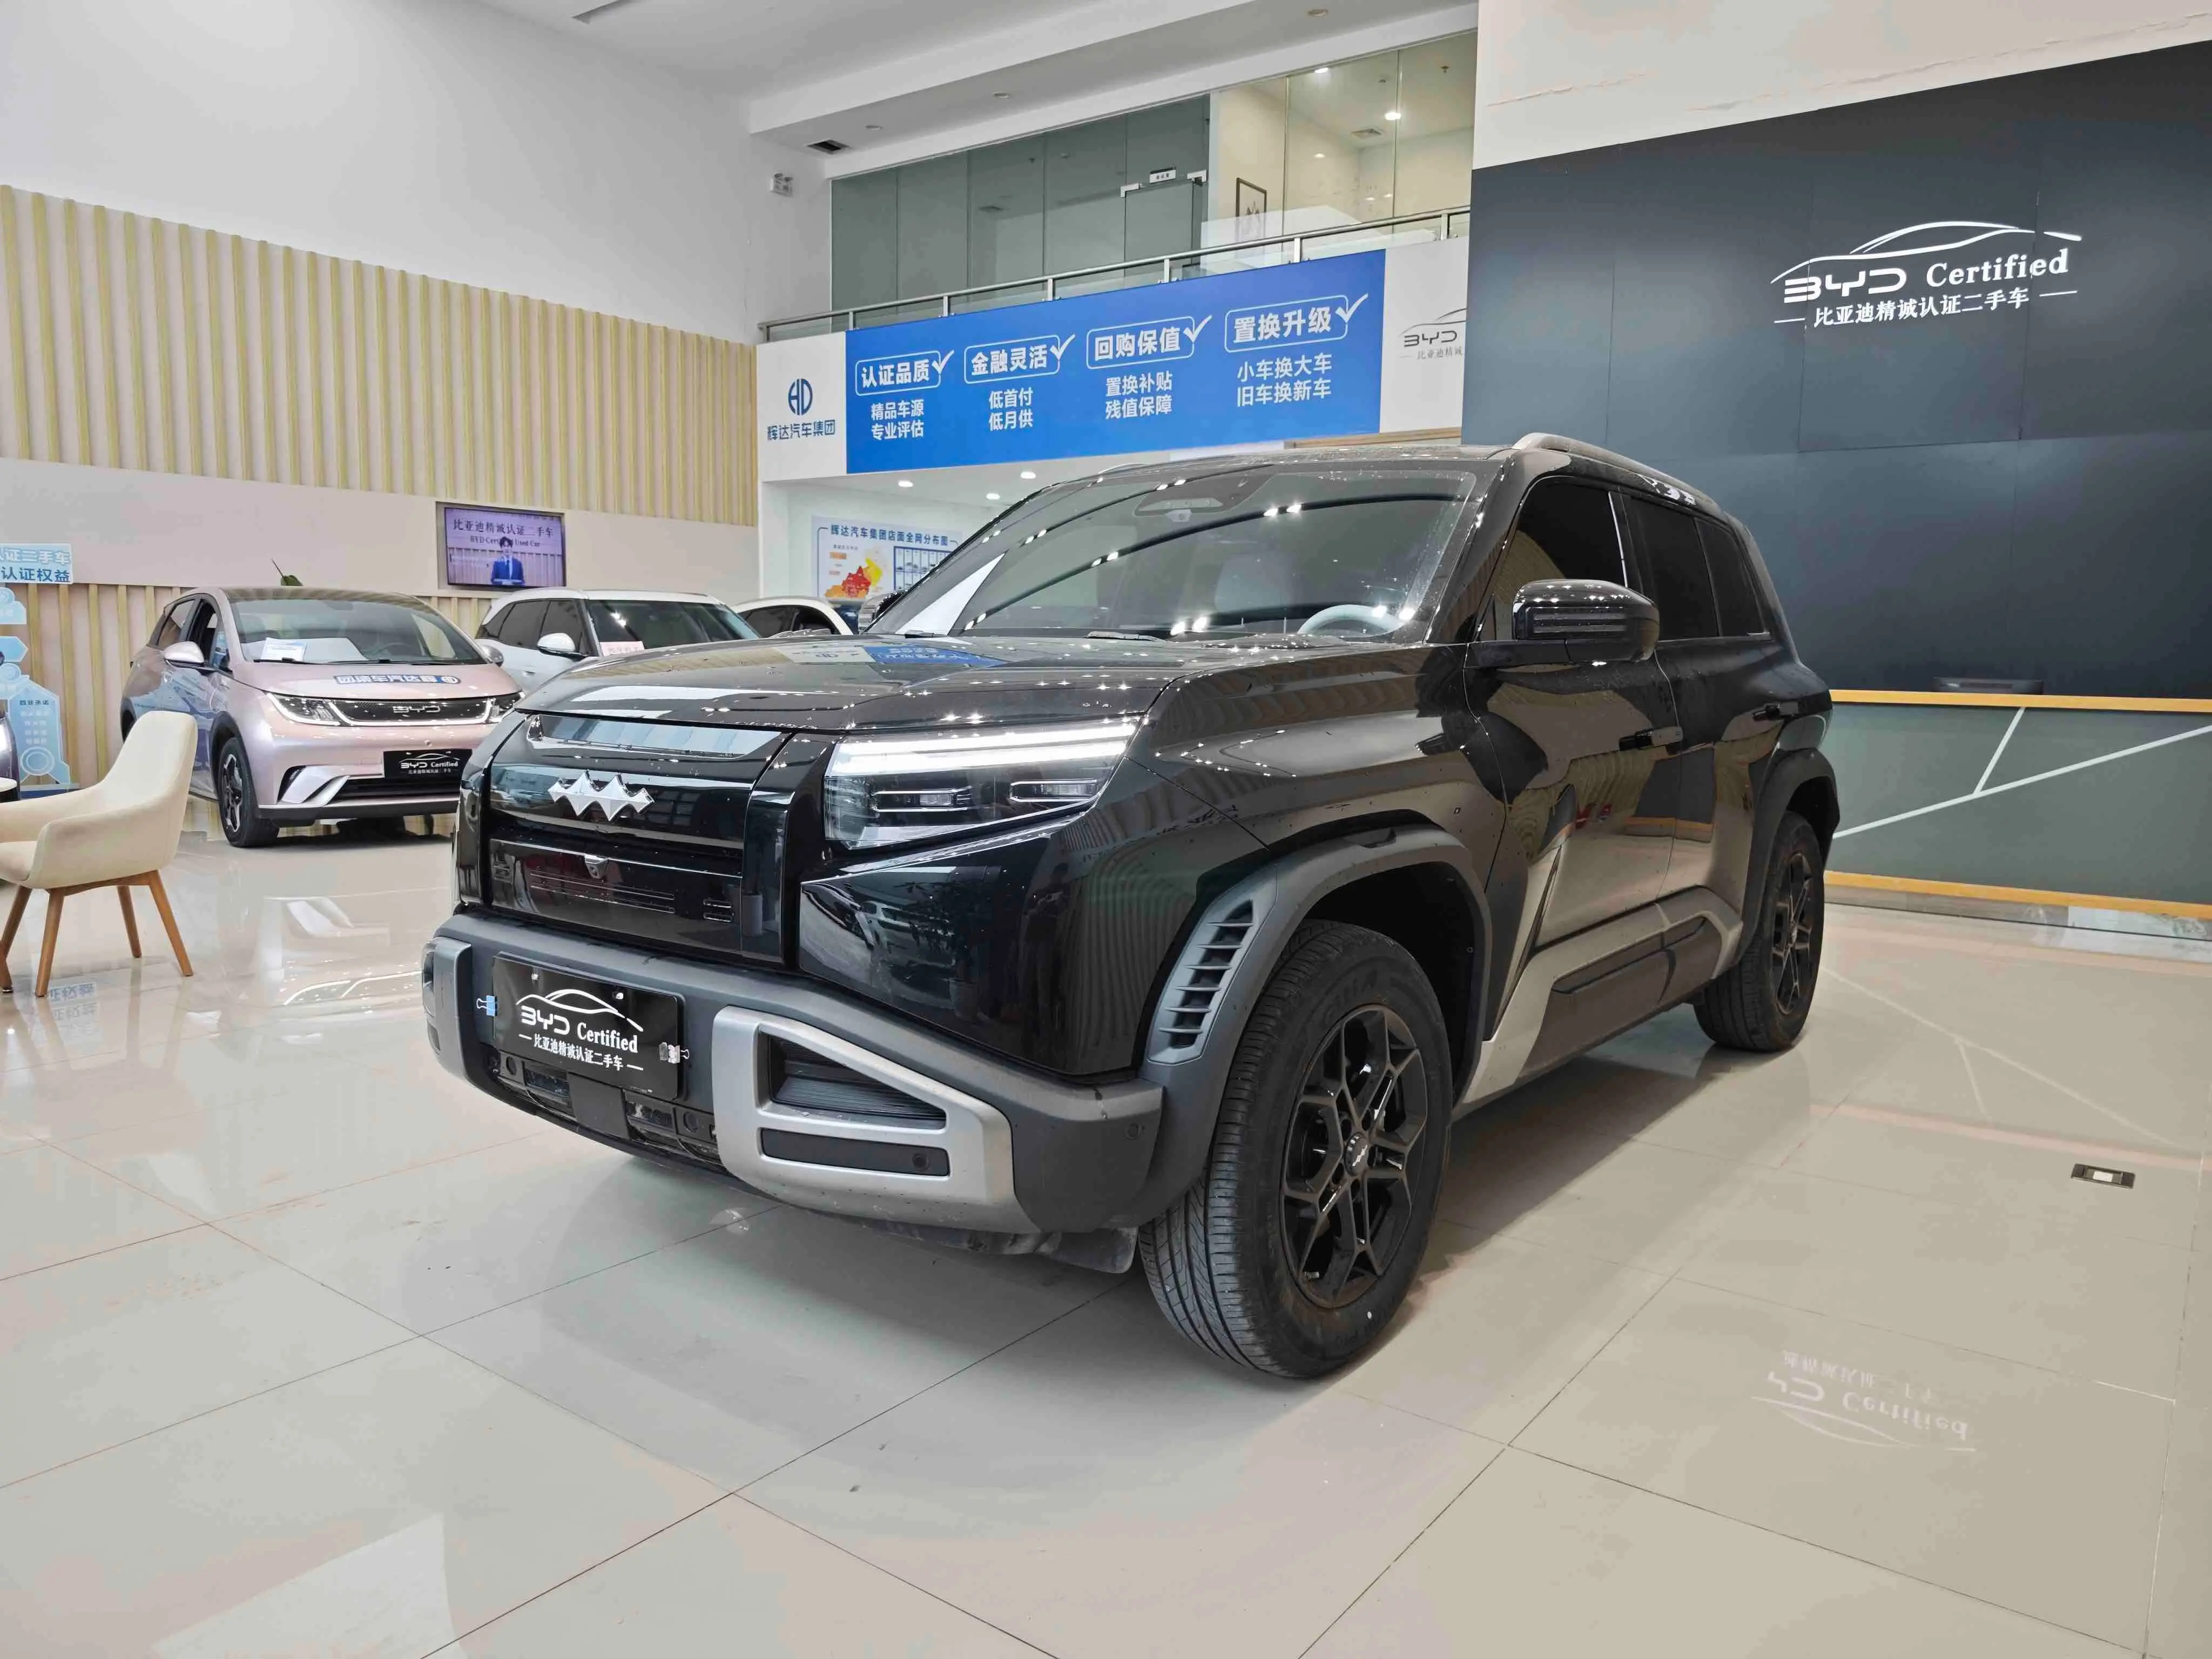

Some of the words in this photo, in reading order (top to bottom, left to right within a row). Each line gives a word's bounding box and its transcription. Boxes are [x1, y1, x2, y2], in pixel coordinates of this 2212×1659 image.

[1784, 267, 1907, 304] BYD
[1926, 248, 2069, 287] Certified
[1813, 286, 2029, 328] 比亚迪精诚认证二手车
[1233, 306, 1331, 343] 置换升级
[1094, 326, 1181, 361] 回购保值
[1404, 330, 1457, 347] BYD
[972, 344, 1048, 376] 金融灵活
[1237, 352, 1332, 382] 小车换大车
[861, 359, 929, 388] 认证品质
[1105, 370, 1173, 396] 置换补贴
[988, 387, 1034, 410] 低首付
[1237, 377, 1332, 407] 旧车换新车
[871, 399, 925, 421] 精品车源
[988, 408, 1034, 431] 低月供
[1105, 394, 1172, 420] 残值保障
[767, 419, 835, 441] 辉达汽车集团
[871, 419, 925, 441] 专业评估
[453, 518, 554, 538] 比亚迪精诚认证二手车
[0, 547, 70, 565] 证二手车
[1, 566, 70, 583] 认证权益
[393, 705, 441, 713] BYD
[521, 1005, 570, 1035] BYD
[577, 1022, 638, 1053] Certified
[534, 1033, 624, 1071] 比亚迪精诚认证二手车
